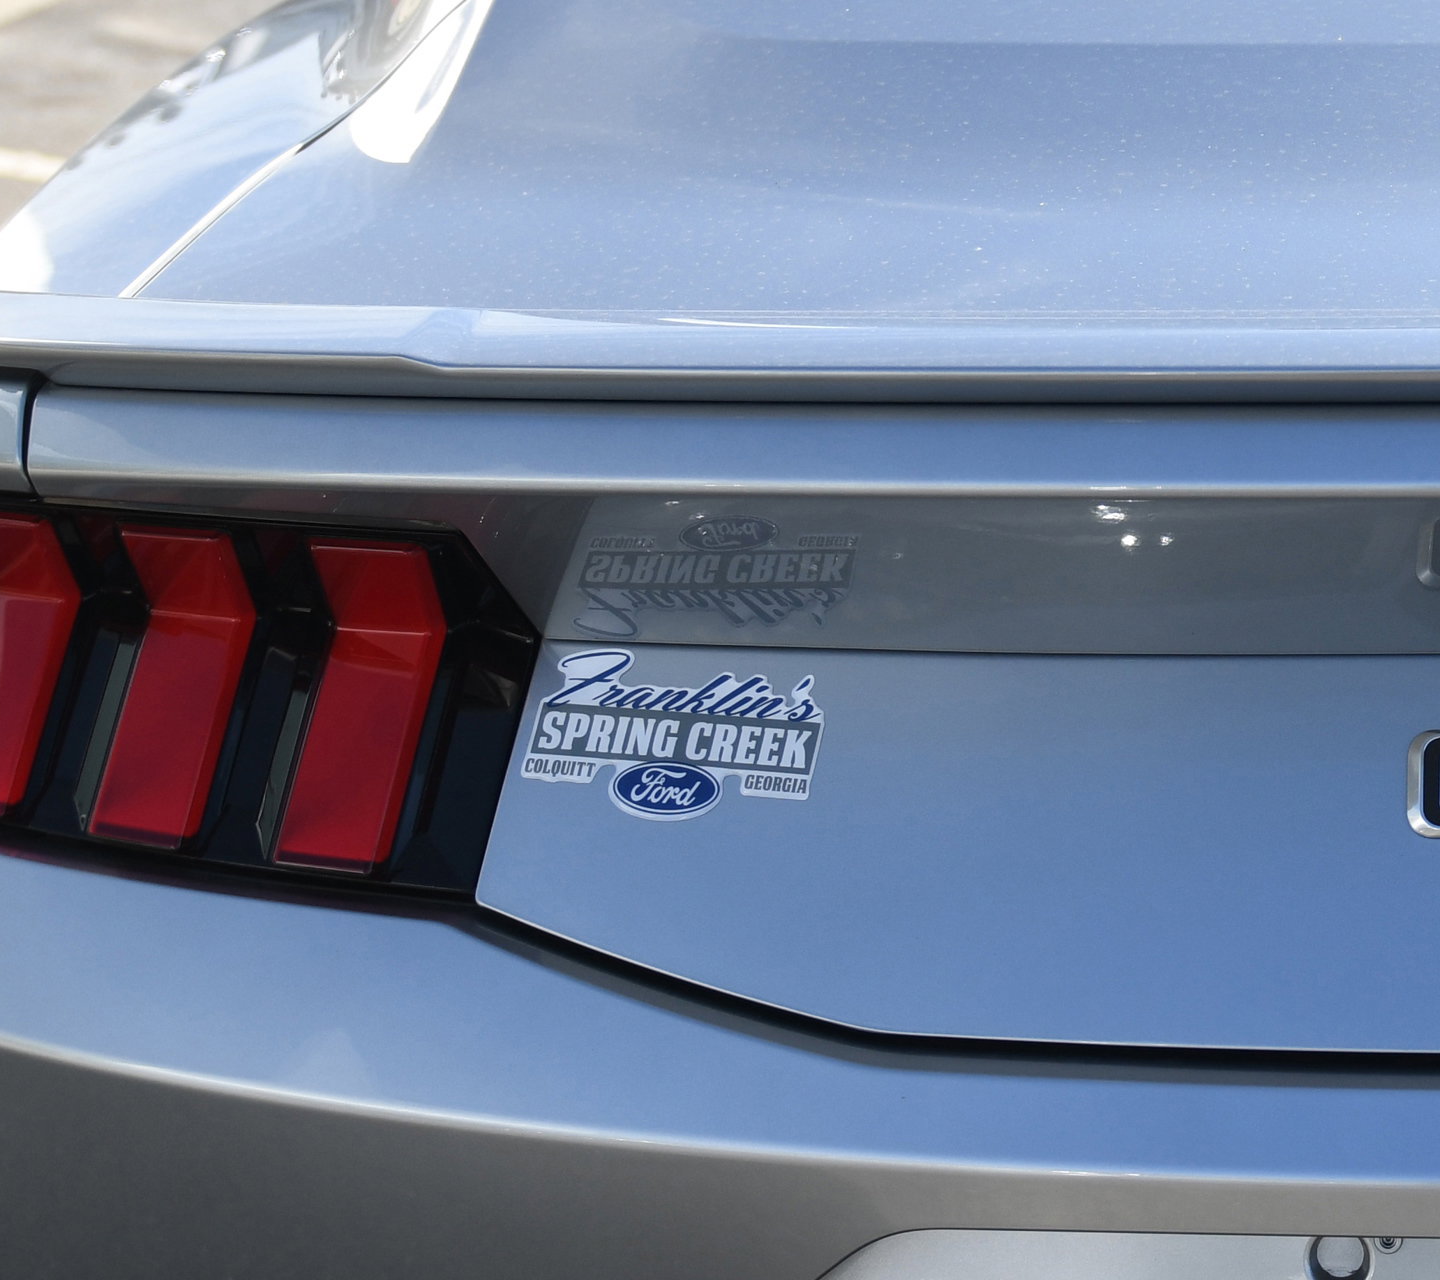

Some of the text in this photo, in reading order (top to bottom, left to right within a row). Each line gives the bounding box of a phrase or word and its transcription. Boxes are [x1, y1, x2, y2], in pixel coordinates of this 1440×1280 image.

[546, 651, 821, 722] Franklin's
[537, 710, 813, 769] SPRING CREEK
[524, 757, 596, 778] COLQUITT
[630, 767, 701, 807] Ford
[744, 773, 807, 794] GEORGIA
